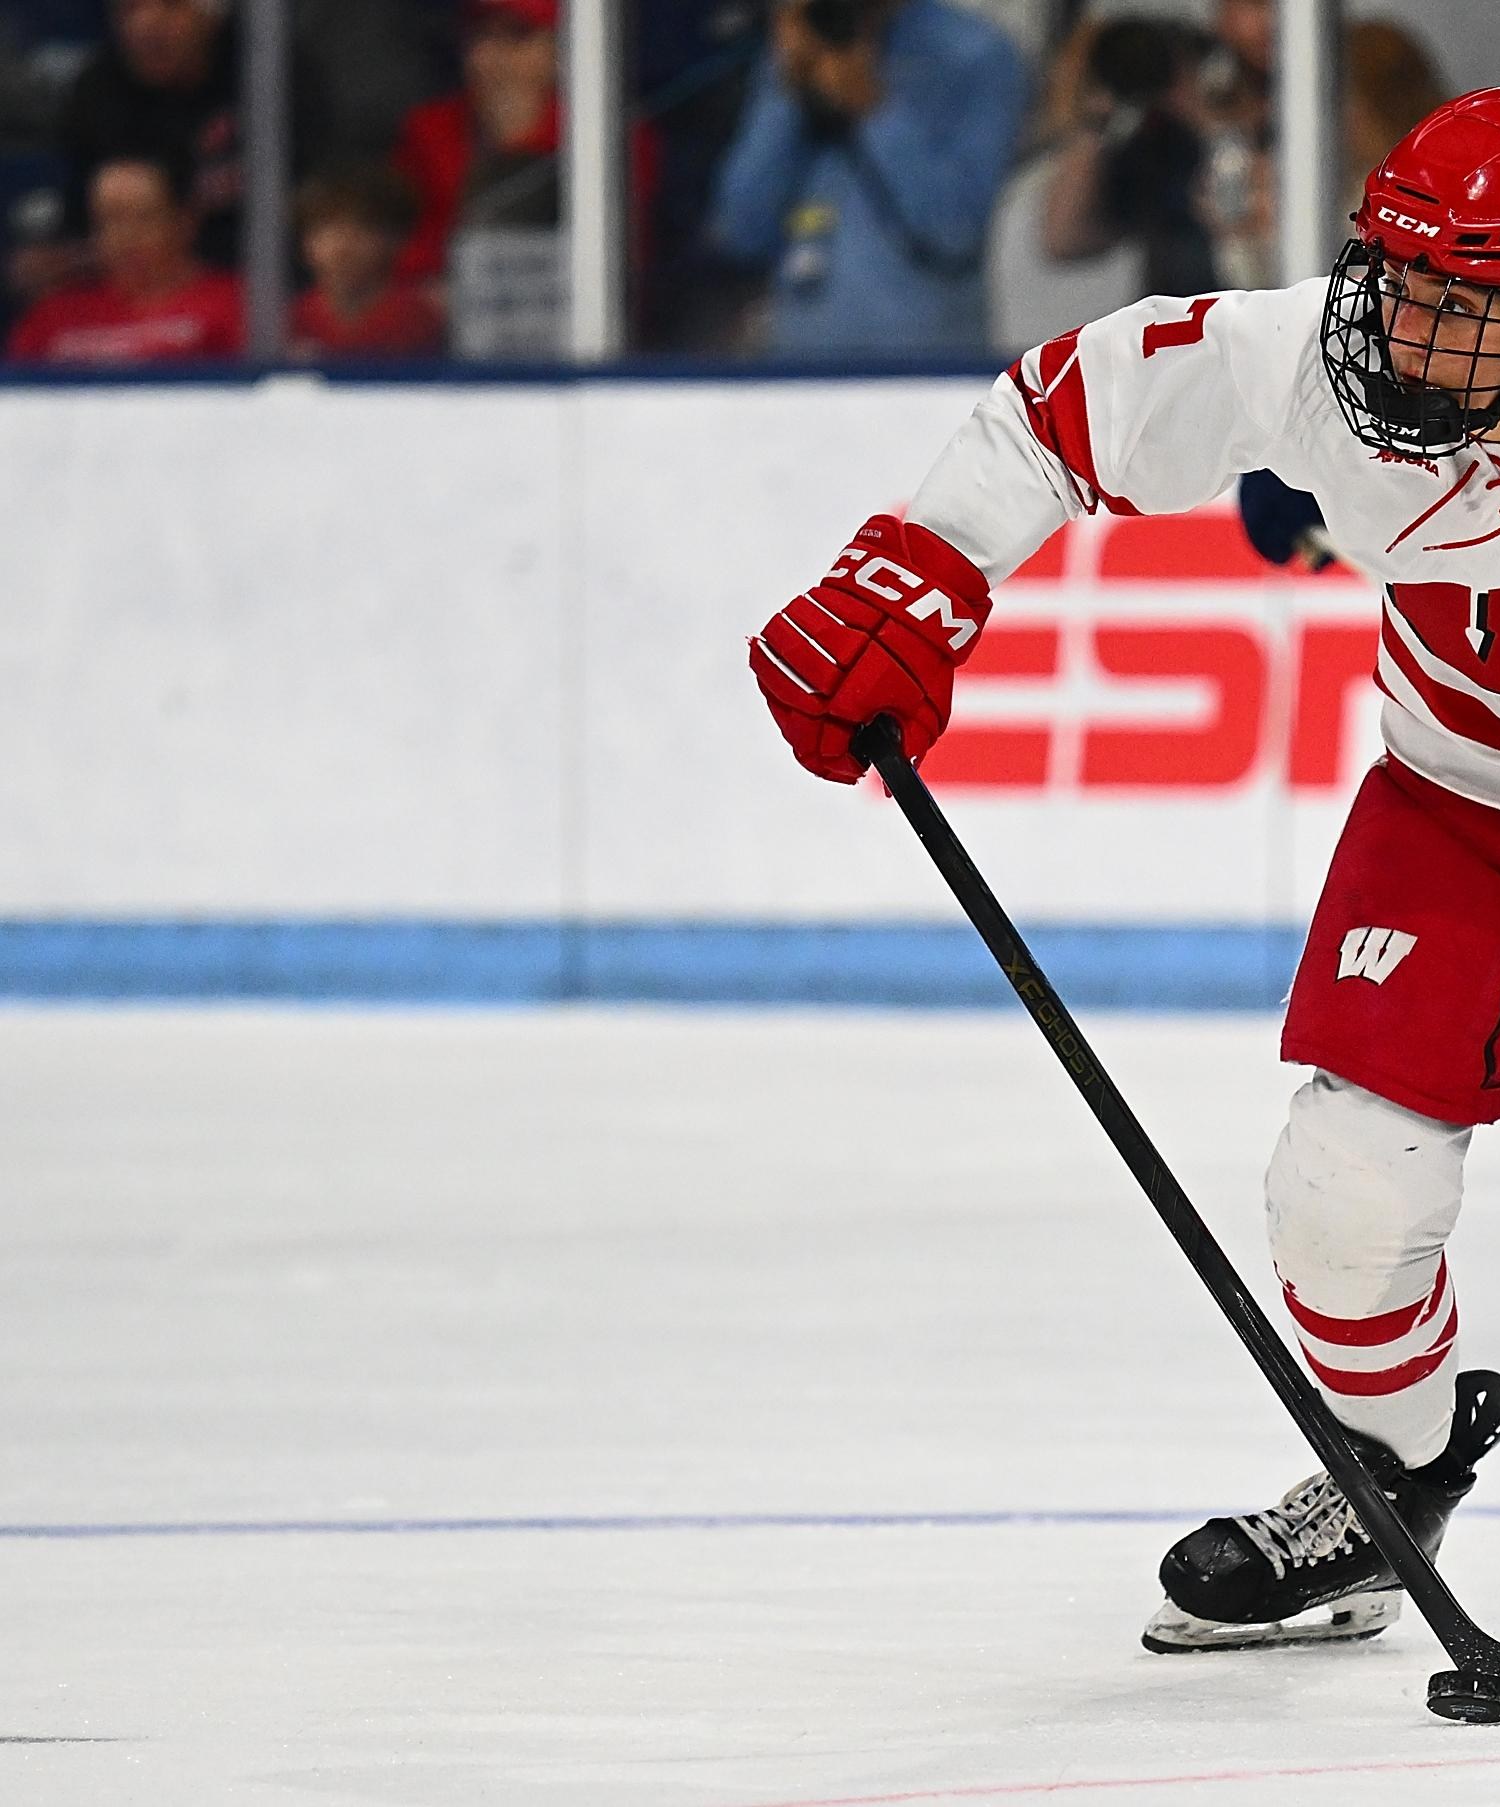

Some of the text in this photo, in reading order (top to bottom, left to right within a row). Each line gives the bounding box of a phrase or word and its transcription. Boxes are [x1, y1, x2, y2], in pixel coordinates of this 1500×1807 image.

[1377, 206, 1441, 238] CCM
[826, 548, 979, 651] CCM
[1335, 926, 1419, 986] W
